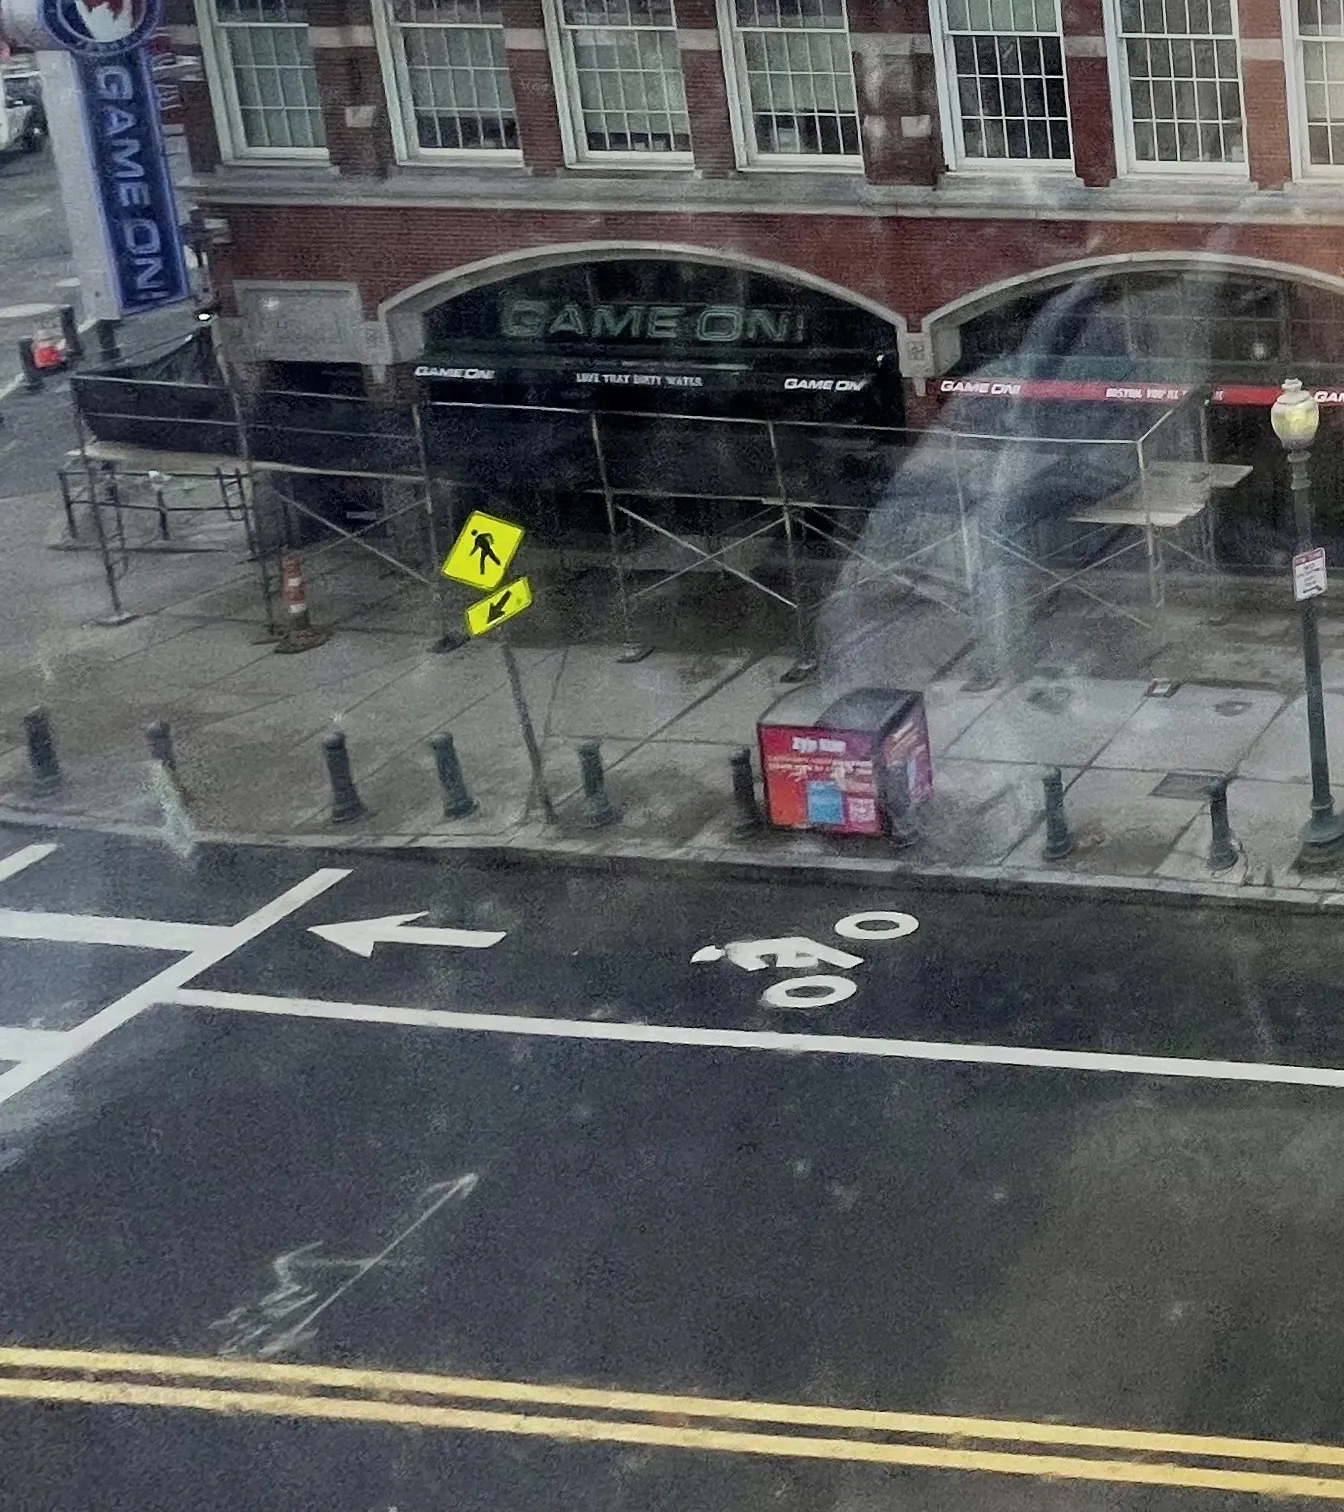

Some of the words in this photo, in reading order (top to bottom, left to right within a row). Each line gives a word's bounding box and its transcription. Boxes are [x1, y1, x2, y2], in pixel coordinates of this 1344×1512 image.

[95, 65, 150, 208] GAME
[501, 299, 685, 339] GAME
[784, 377, 832, 391] GAME
[940, 379, 988, 394] GAME
